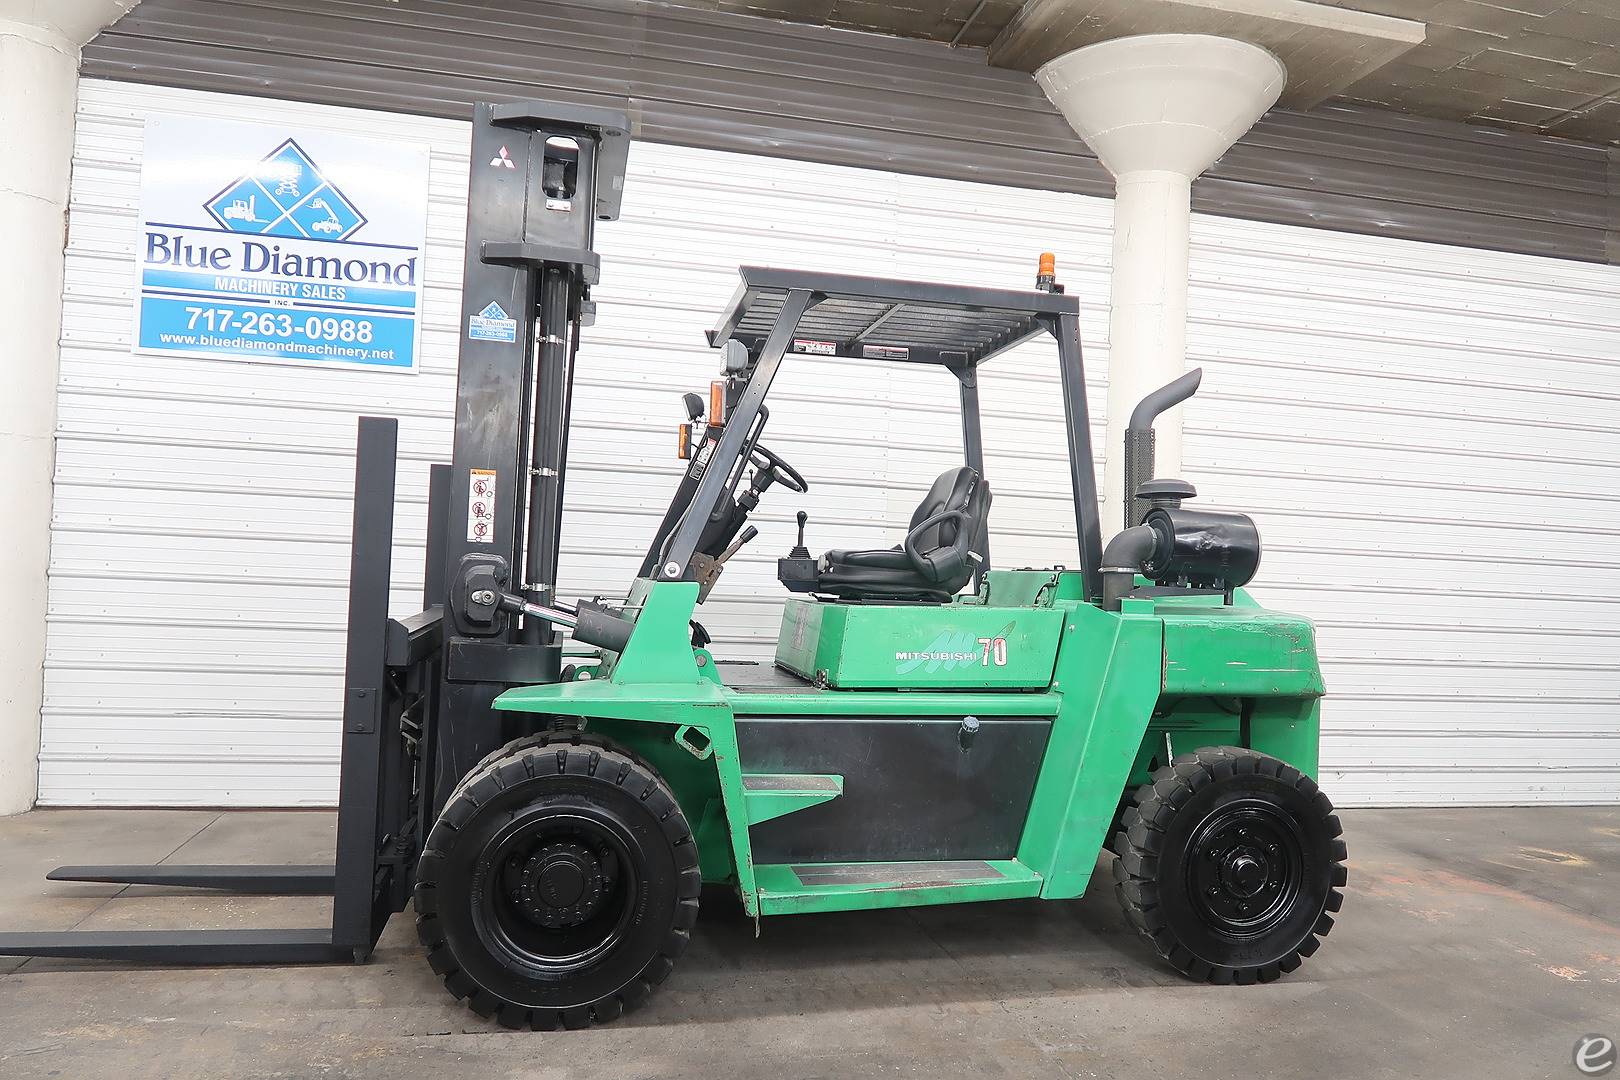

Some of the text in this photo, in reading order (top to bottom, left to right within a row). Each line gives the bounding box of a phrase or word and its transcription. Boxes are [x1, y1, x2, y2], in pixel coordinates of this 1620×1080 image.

[144, 232, 417, 287] Blue Diamond
[215, 277, 346, 301] MACHINERY SALES
[185, 306, 373, 344] 717-263-0988
[159, 333, 395, 360] www.bluediamondmachinery.net
[895, 637, 1008, 666] MITSUBISHI 70
